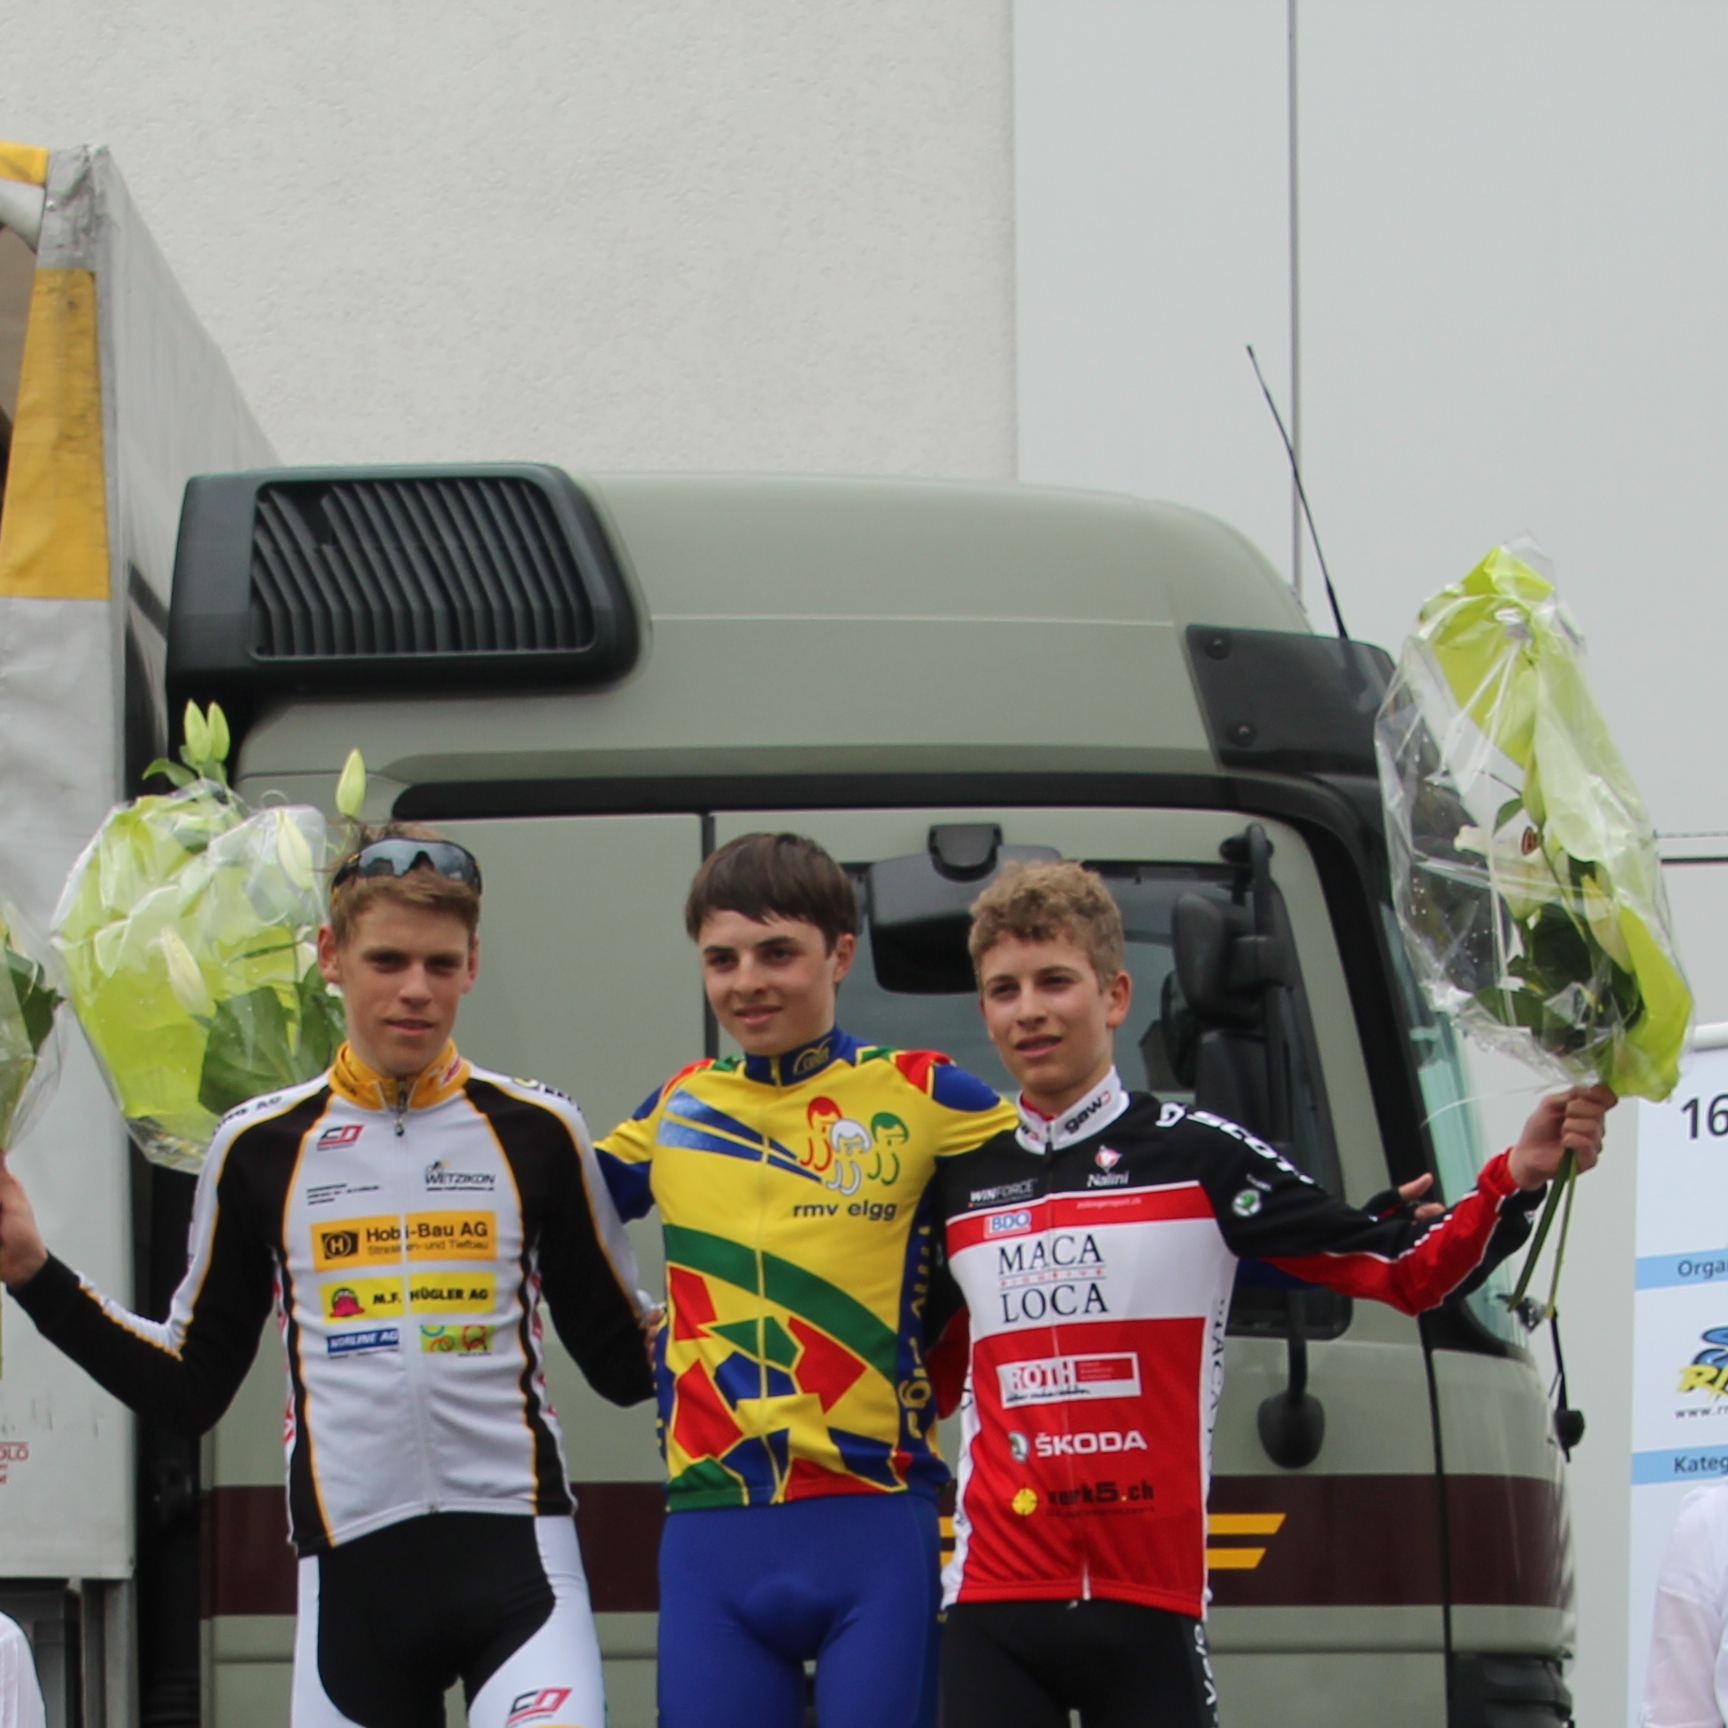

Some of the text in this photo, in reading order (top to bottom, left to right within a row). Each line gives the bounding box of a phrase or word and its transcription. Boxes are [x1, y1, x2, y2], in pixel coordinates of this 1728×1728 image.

[793, 1200, 897, 1221] rmv elgg
[991, 1210, 1030, 1232] BDO
[461, 1221, 488, 1237] AG
[998, 1233, 1104, 1275] MACA
[469, 1288, 489, 1301] AG
[1000, 1282, 1110, 1323] LOCA
[1035, 1430, 1148, 1458] ŠKODA
